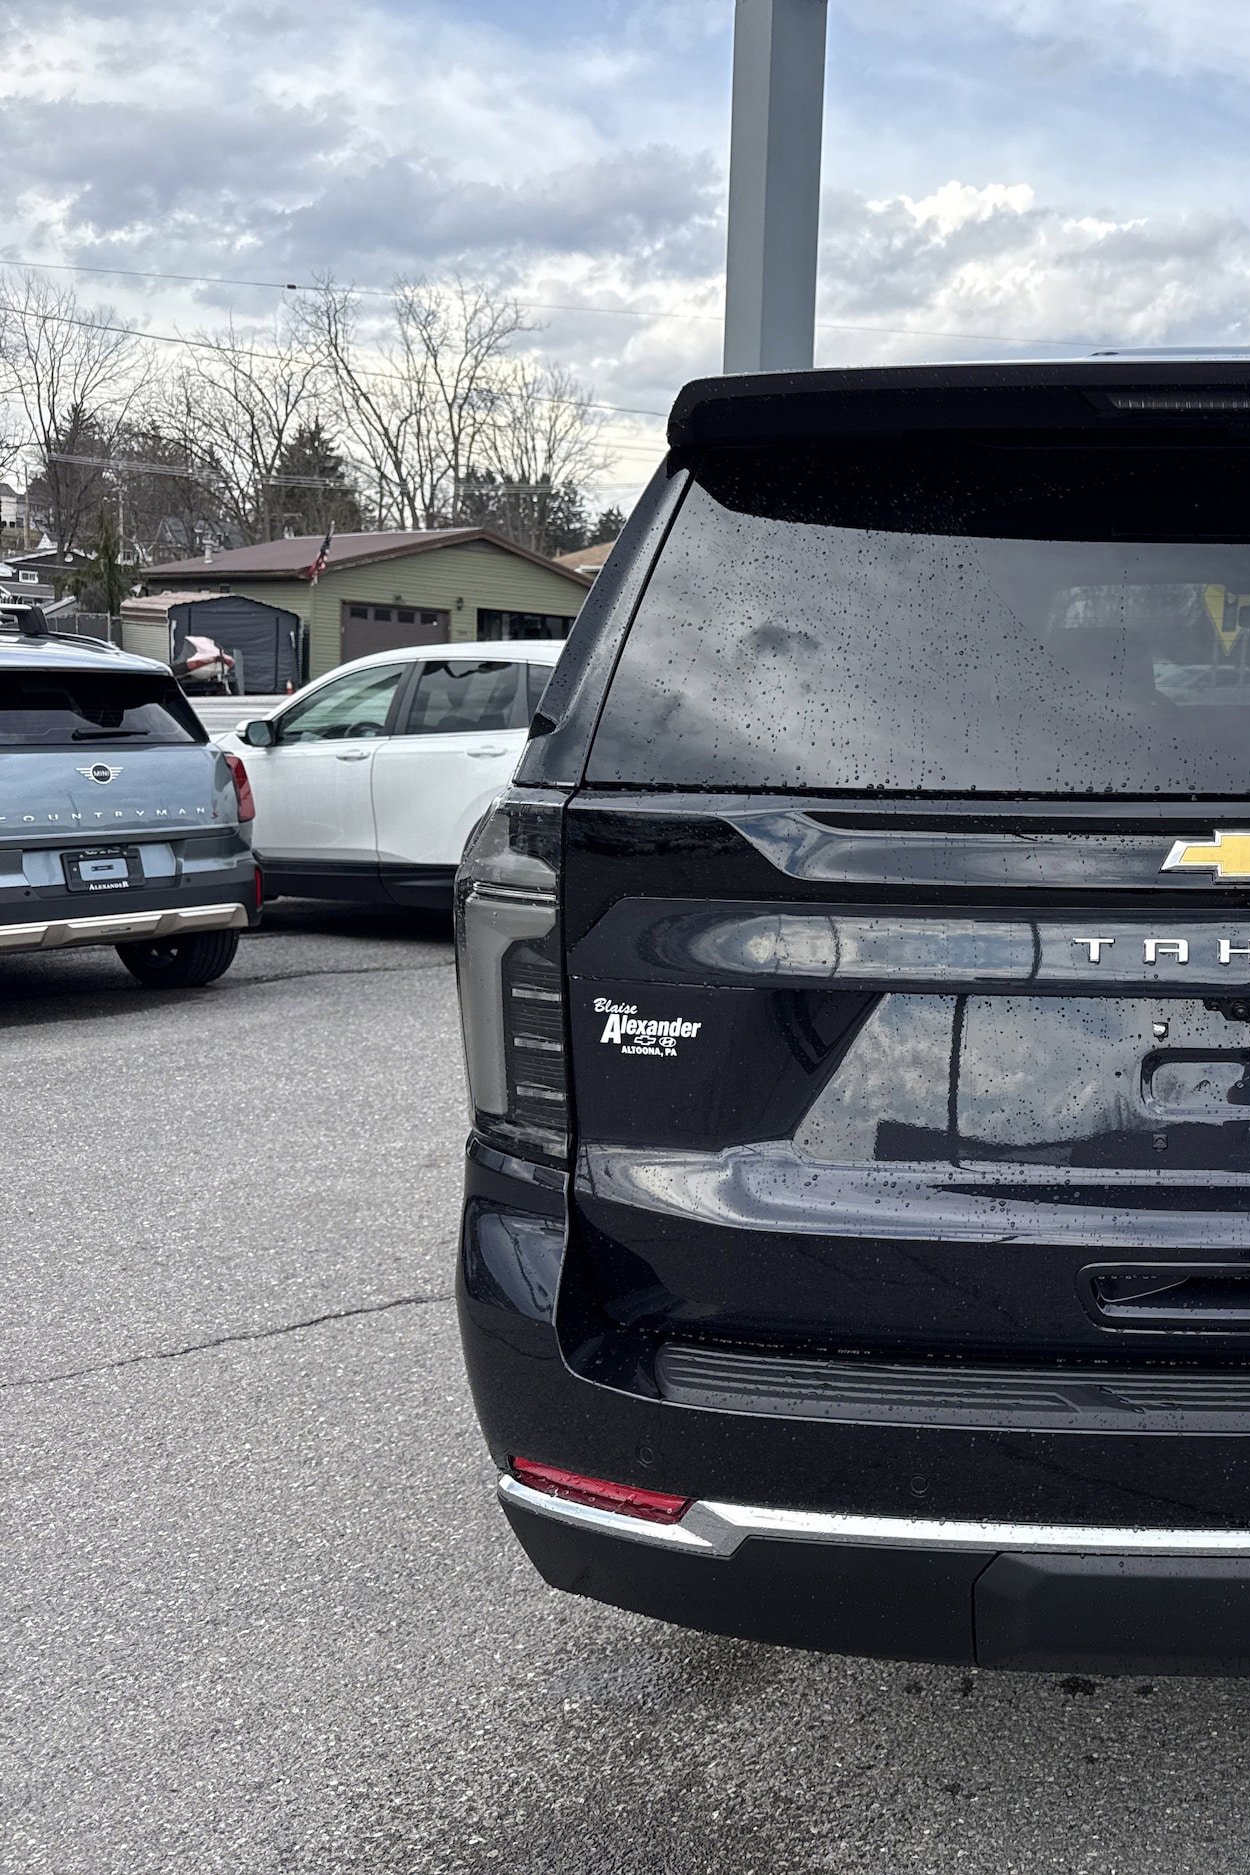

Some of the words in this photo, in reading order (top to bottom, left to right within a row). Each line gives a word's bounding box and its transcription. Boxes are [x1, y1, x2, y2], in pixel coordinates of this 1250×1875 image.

[593, 997, 638, 1015] Blaise
[600, 1013, 702, 1044] Alexander
[621, 1045, 664, 1057] ALTOONA,
[665, 1048, 677, 1057] PA
